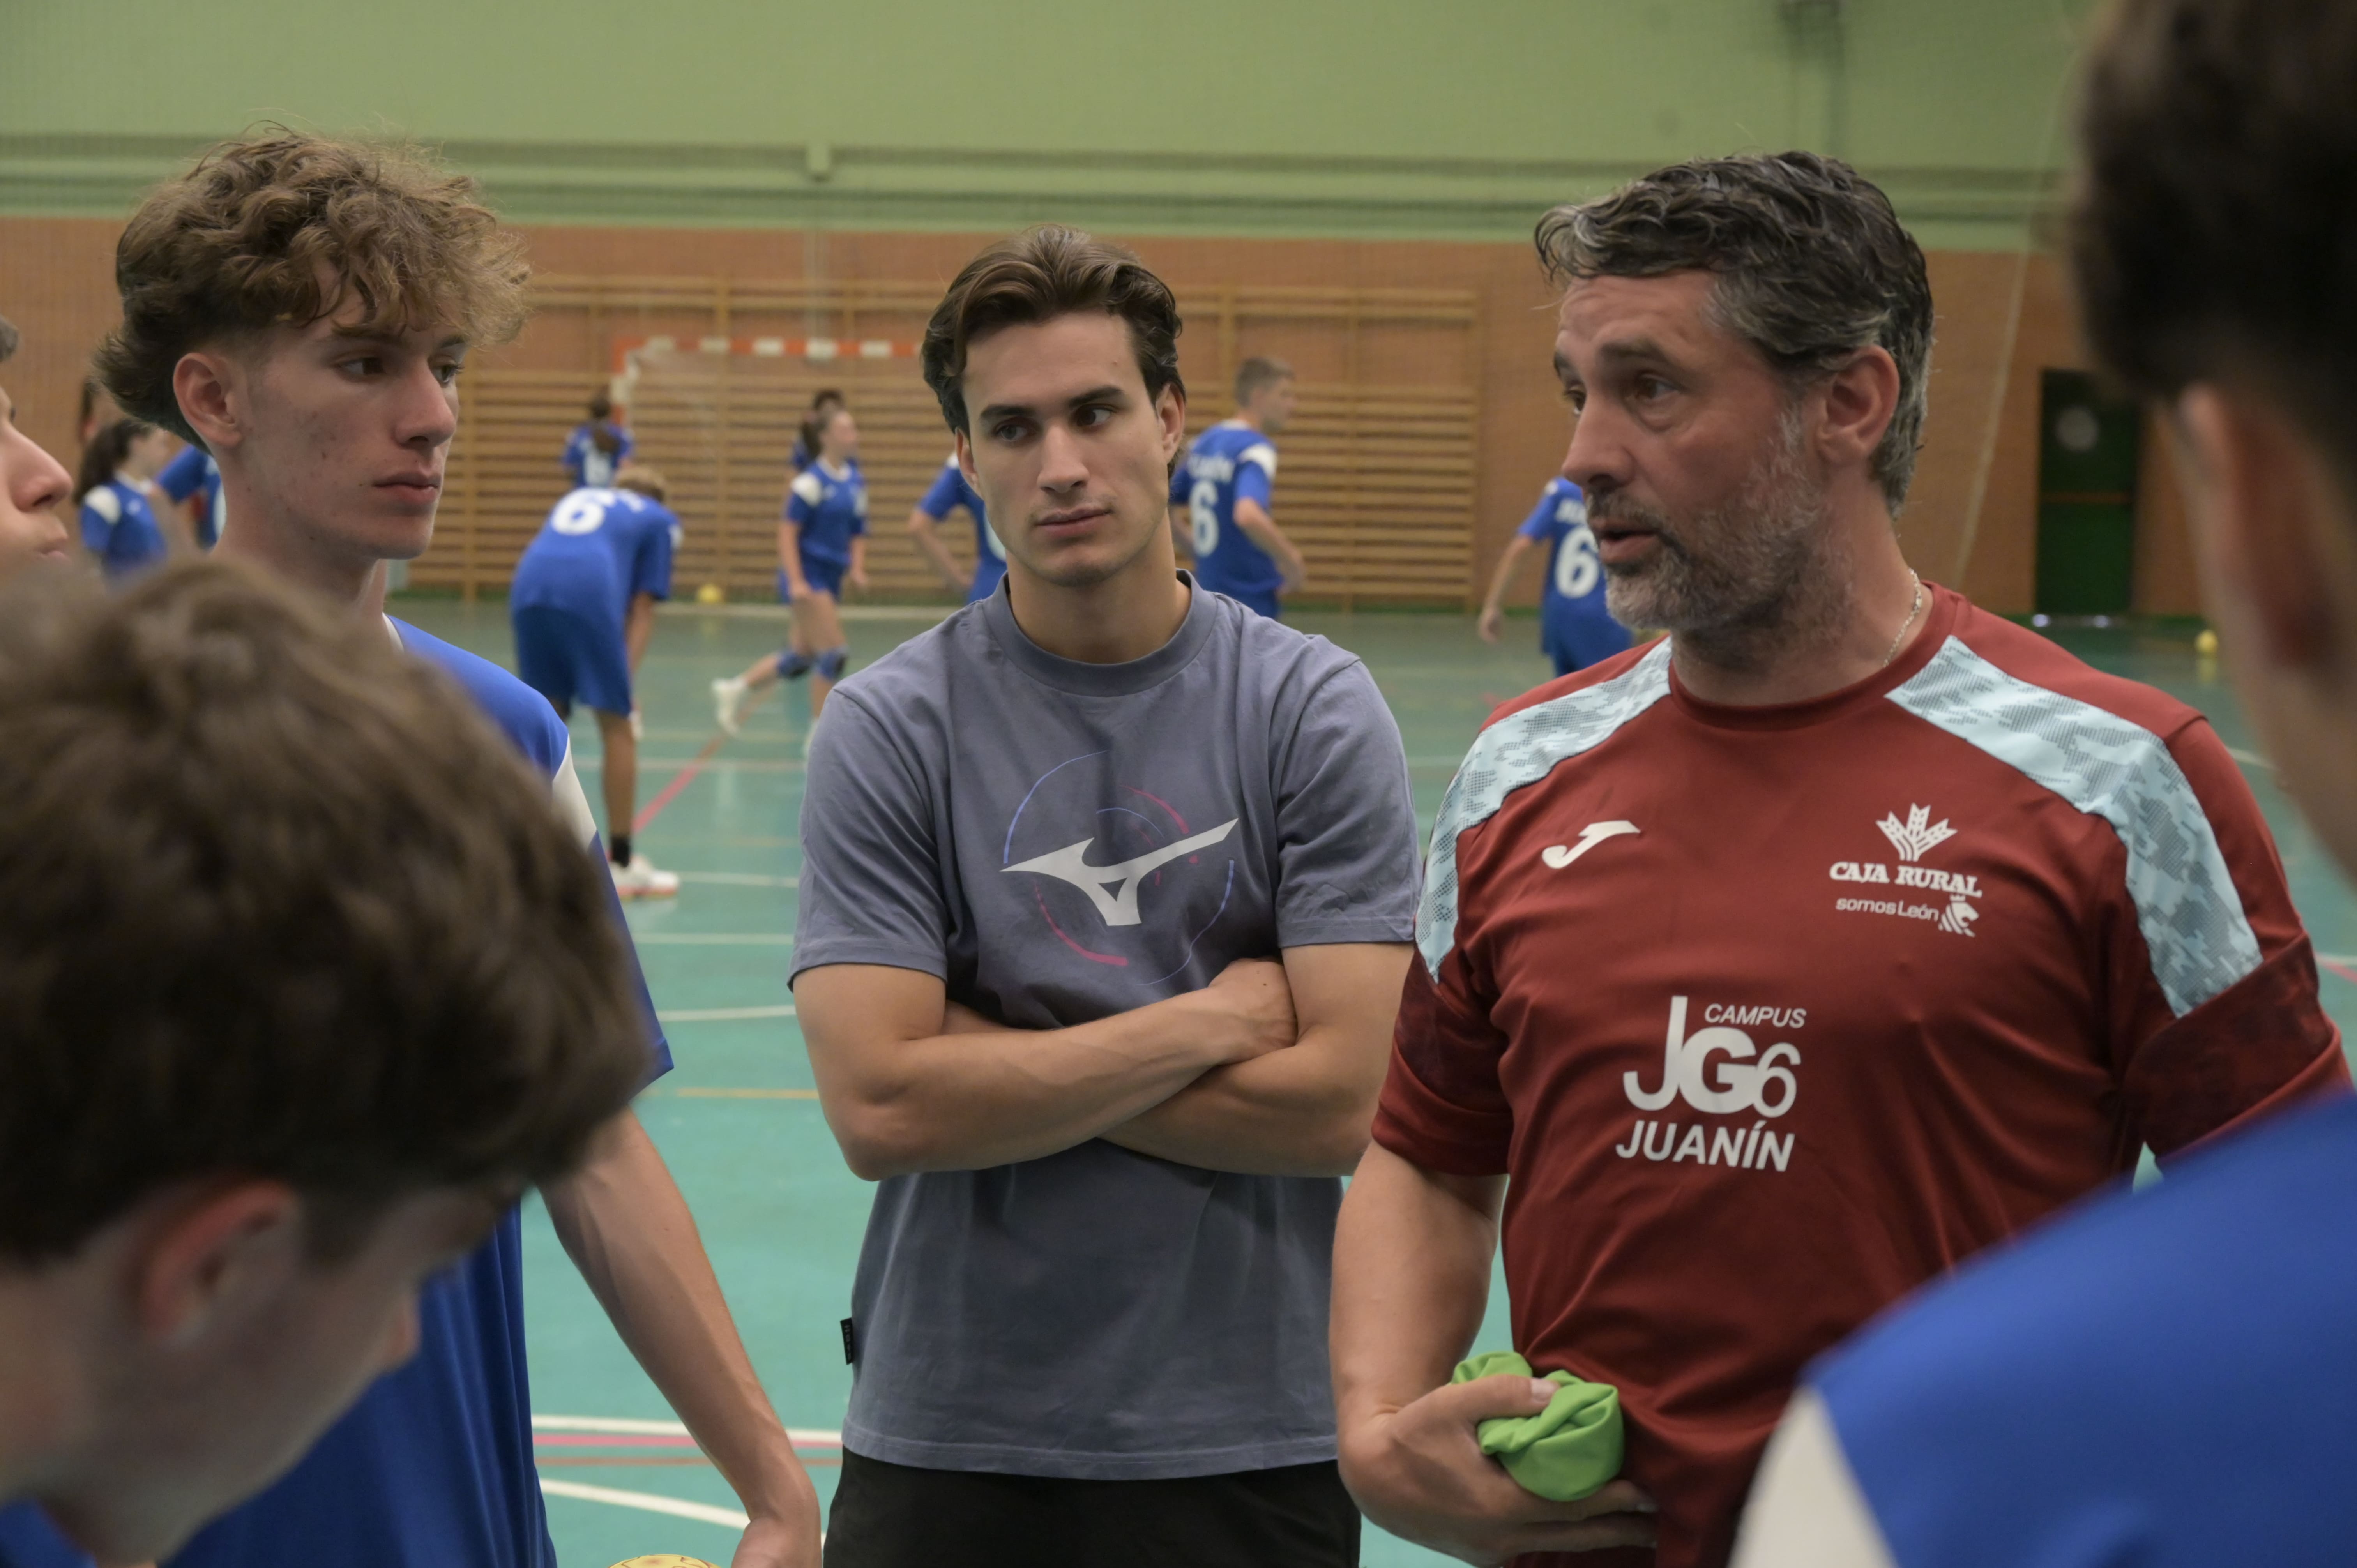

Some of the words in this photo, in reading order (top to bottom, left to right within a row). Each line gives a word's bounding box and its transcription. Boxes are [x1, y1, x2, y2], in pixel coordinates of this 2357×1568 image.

[552, 487, 615, 534] 6
[1190, 482, 1218, 556] 6
[1556, 527, 1599, 598] 6
[1830, 862, 1890, 883] CAJA
[1895, 866, 1982, 898] RURAL
[1705, 1004, 1806, 1027] CAMPUS
[1624, 996, 1801, 1117] JG6
[1617, 1120, 1795, 1171] JUANÍN
